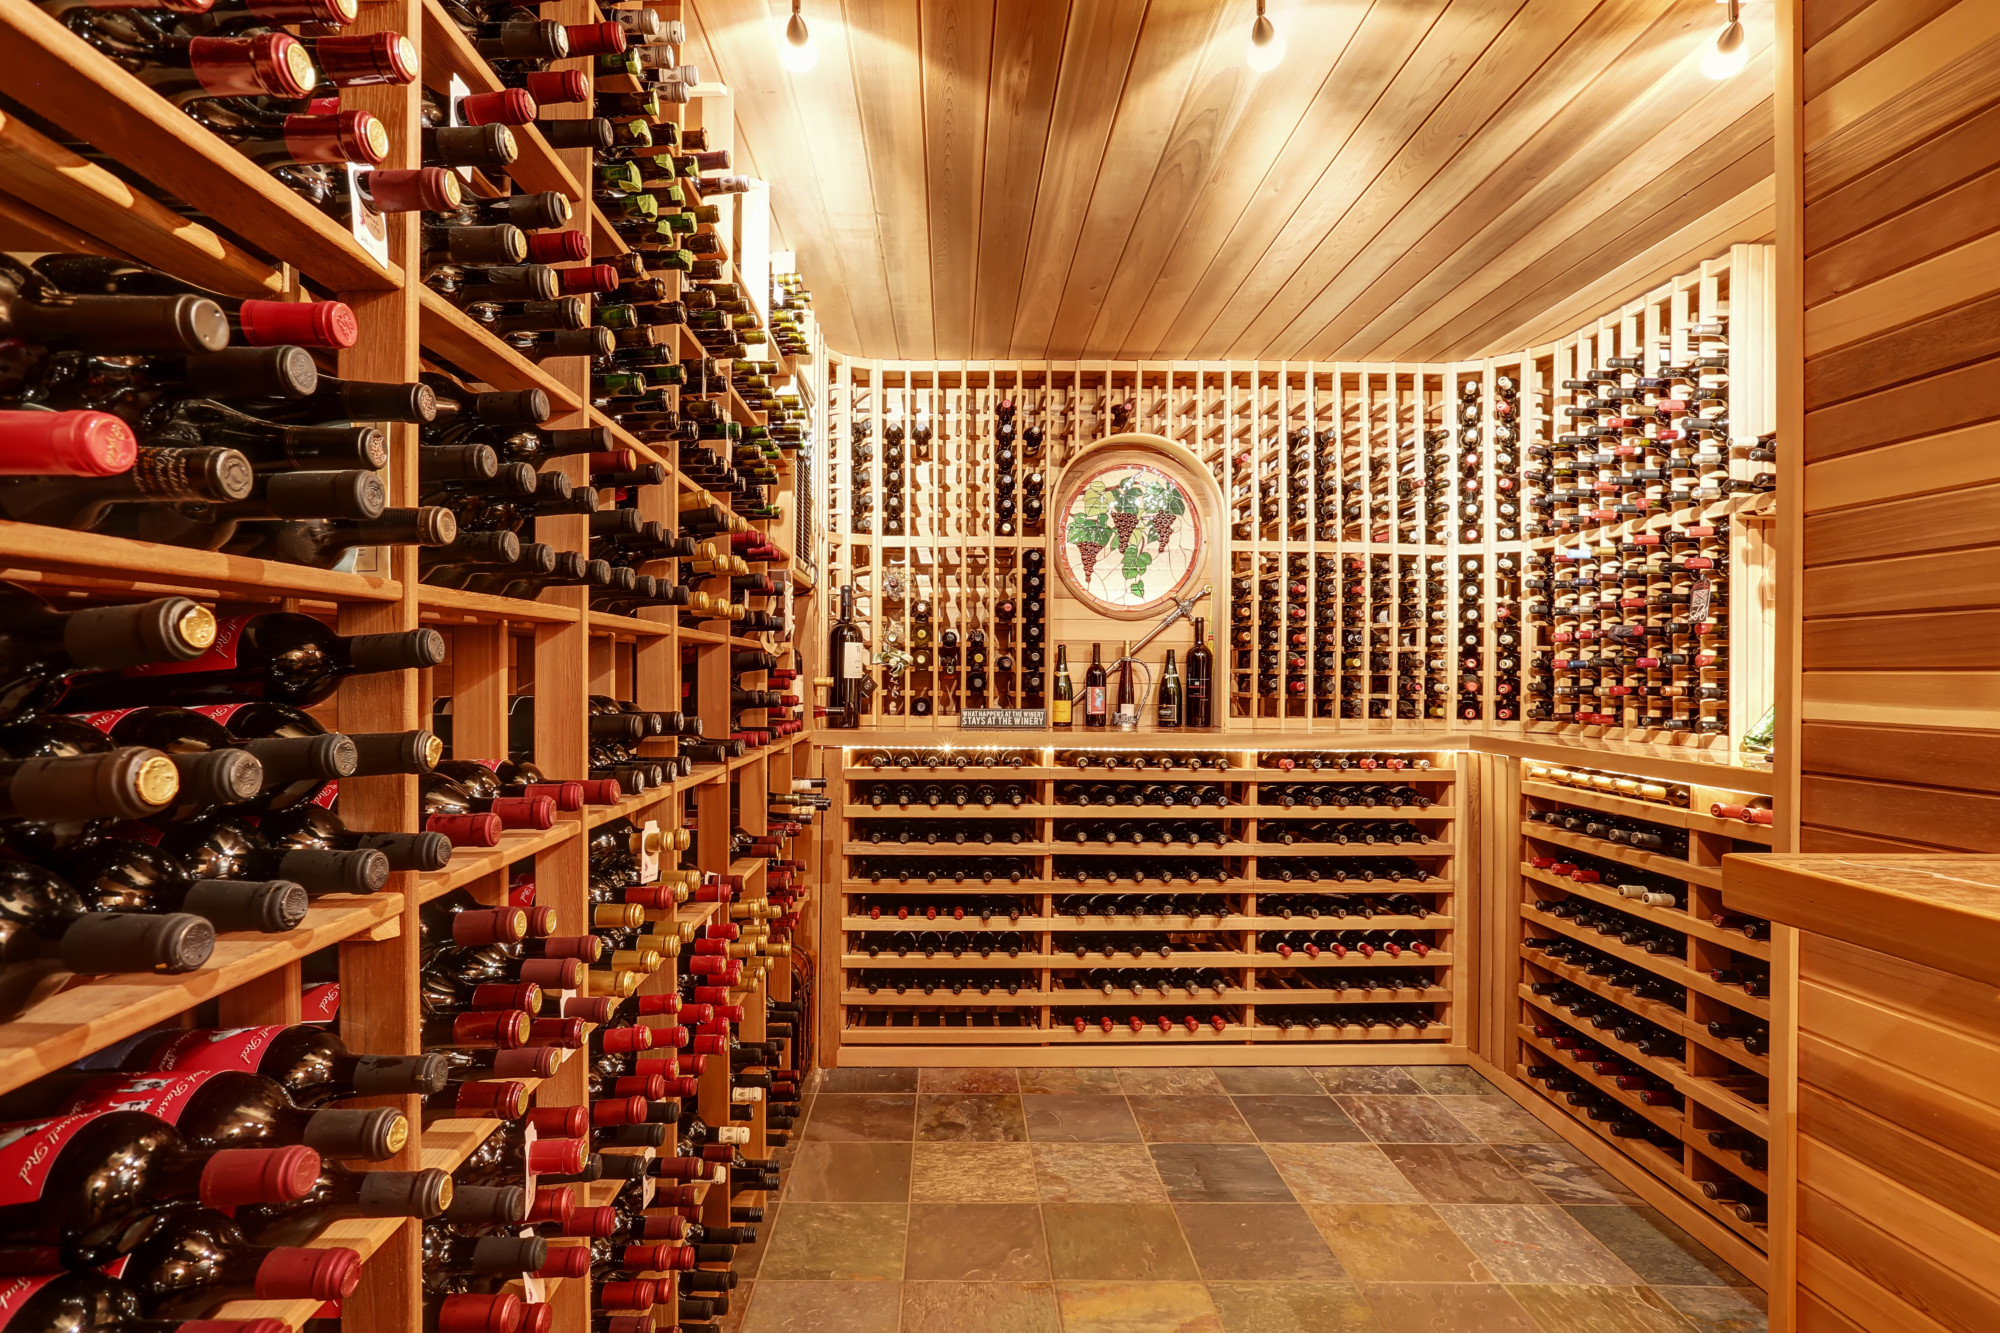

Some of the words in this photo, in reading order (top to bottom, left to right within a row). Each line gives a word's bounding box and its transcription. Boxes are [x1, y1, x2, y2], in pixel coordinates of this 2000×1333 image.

[215, 628, 232, 658] Red
[208, 704, 228, 720] Re
[962, 717, 986, 725] STAYS
[987, 717, 996, 725] AT
[998, 717, 1012, 725] THE
[1014, 717, 1044, 725] WINERY
[520, 888, 531, 903] Red
[318, 989, 338, 1014] Red
[239, 1038, 262, 1065] Red
[154, 1078, 189, 1118] Russe
[17, 1140, 49, 1186] Red
